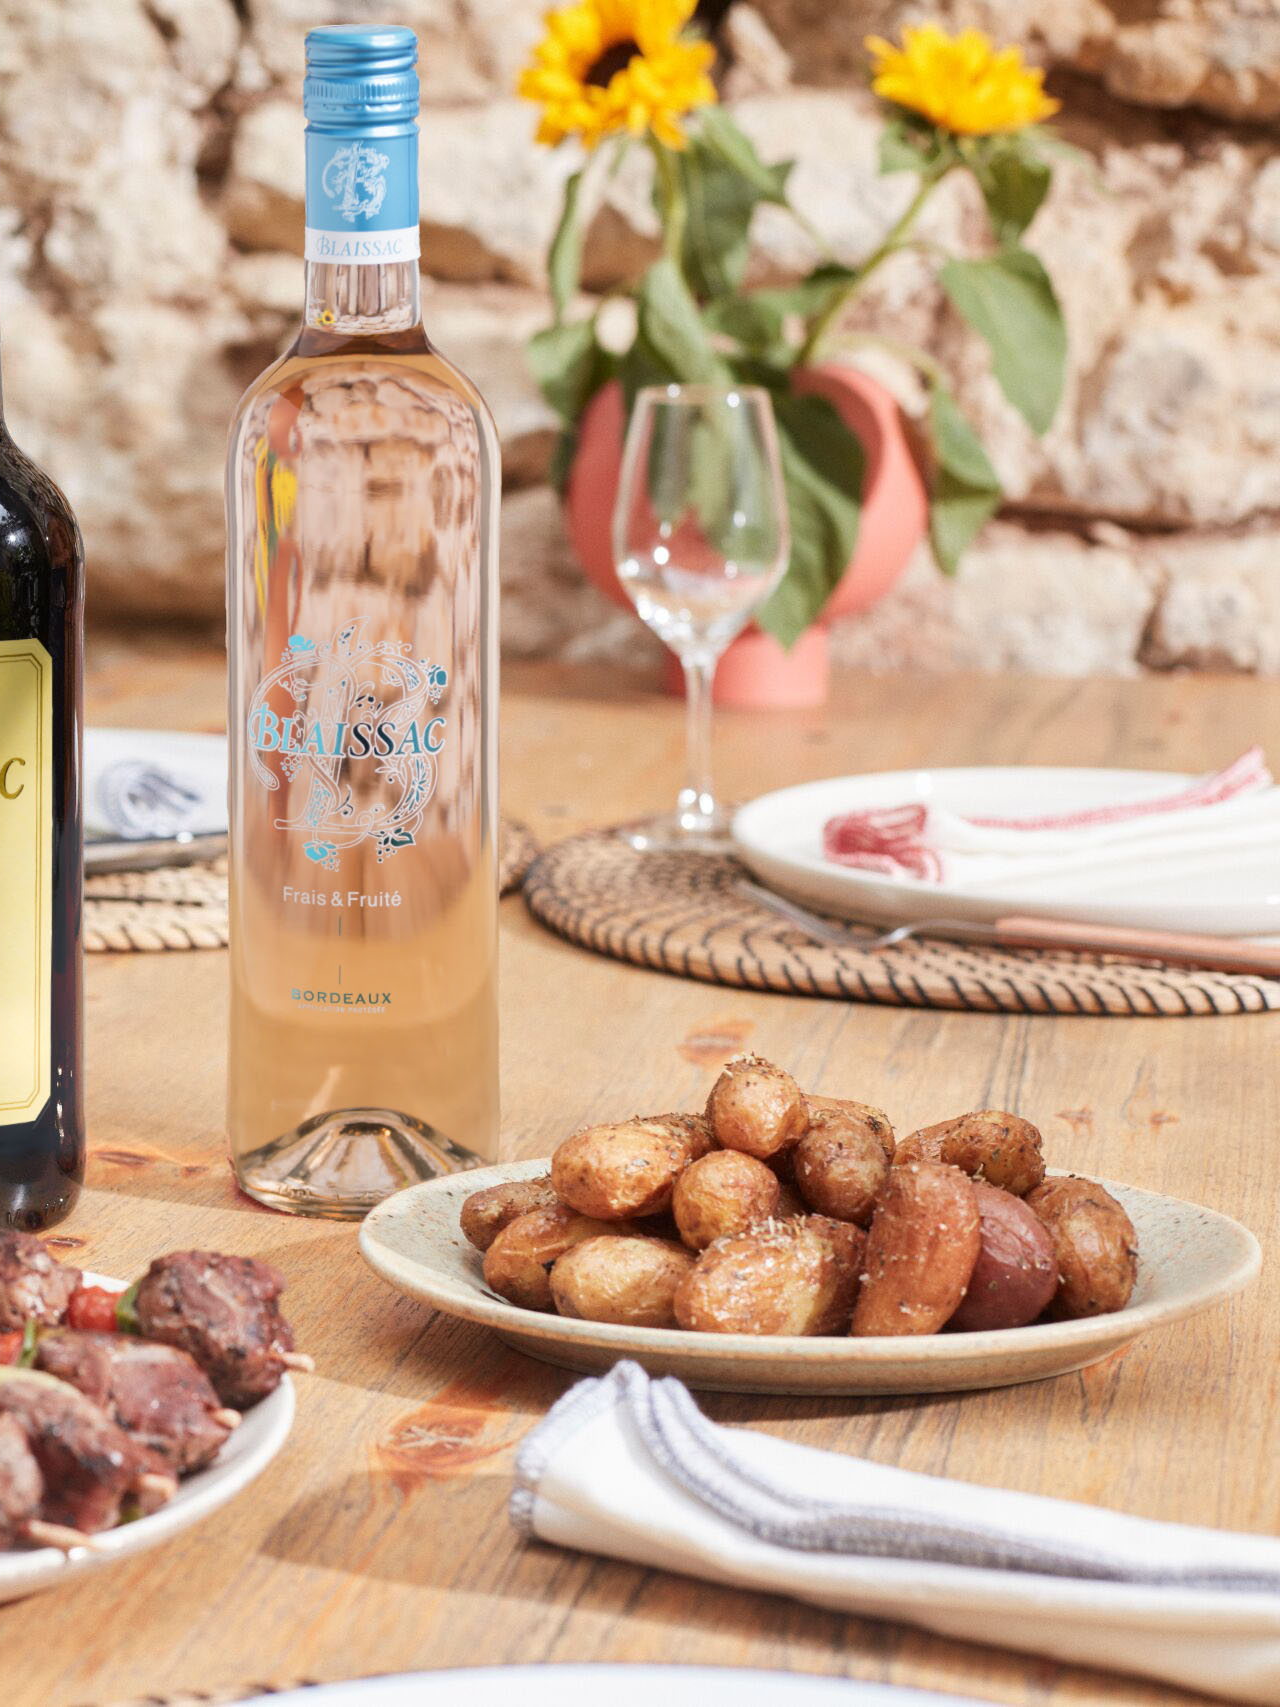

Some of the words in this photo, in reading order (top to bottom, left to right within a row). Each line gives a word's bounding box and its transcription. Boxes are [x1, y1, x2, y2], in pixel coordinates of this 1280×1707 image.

[316, 233, 401, 256] BLAISSAC
[249, 703, 447, 760] BLAISSAC
[283, 886, 327, 906] Frais
[330, 891, 344, 907] &
[347, 890, 402, 907] Fruité
[291, 987, 391, 1005] BORDEAUX
